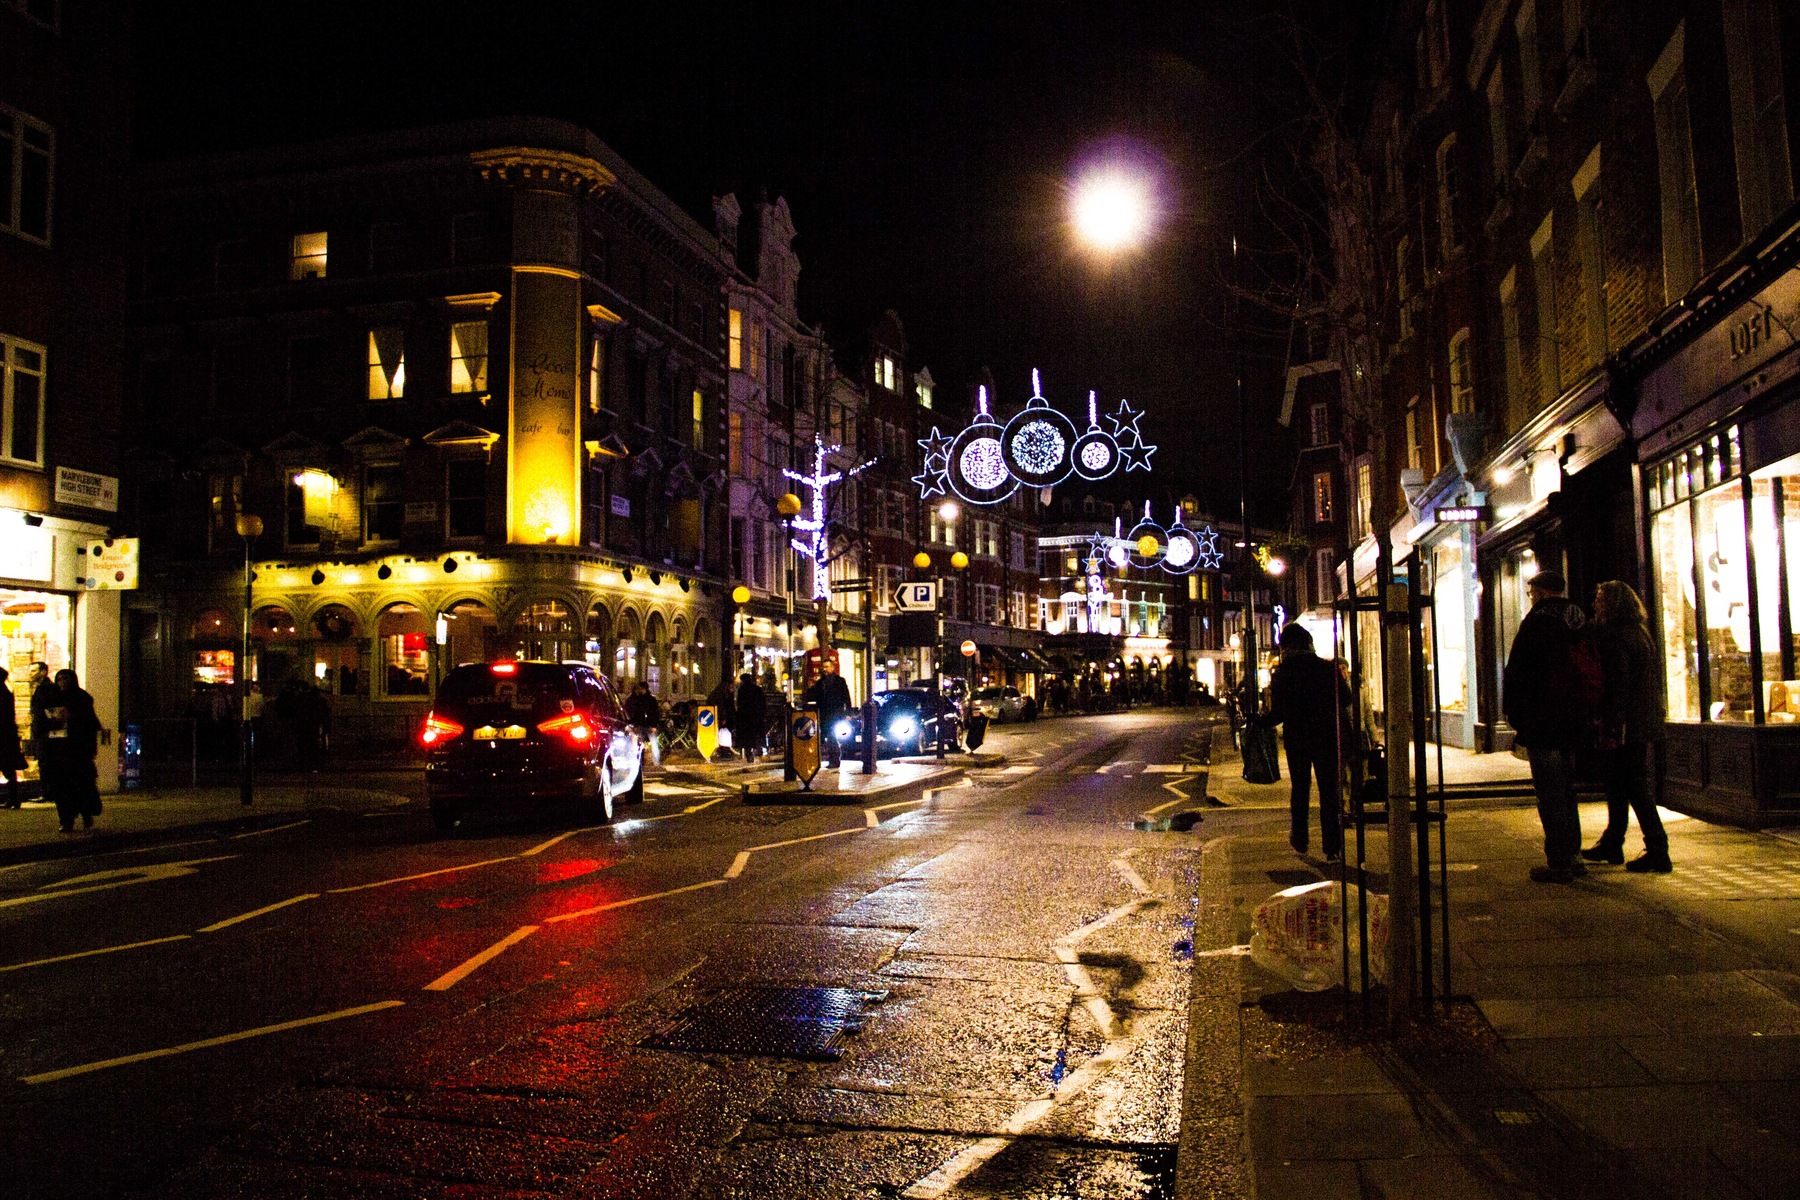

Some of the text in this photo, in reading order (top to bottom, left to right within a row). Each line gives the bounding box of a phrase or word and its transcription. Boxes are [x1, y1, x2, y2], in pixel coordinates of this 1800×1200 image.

[1731, 306, 1772, 360] LOFT
[61, 470, 102, 488] MARYLEBONE
[60, 480, 77, 493] HIGH
[77, 482, 101, 497] STREET
[916, 586, 928, 601] P
